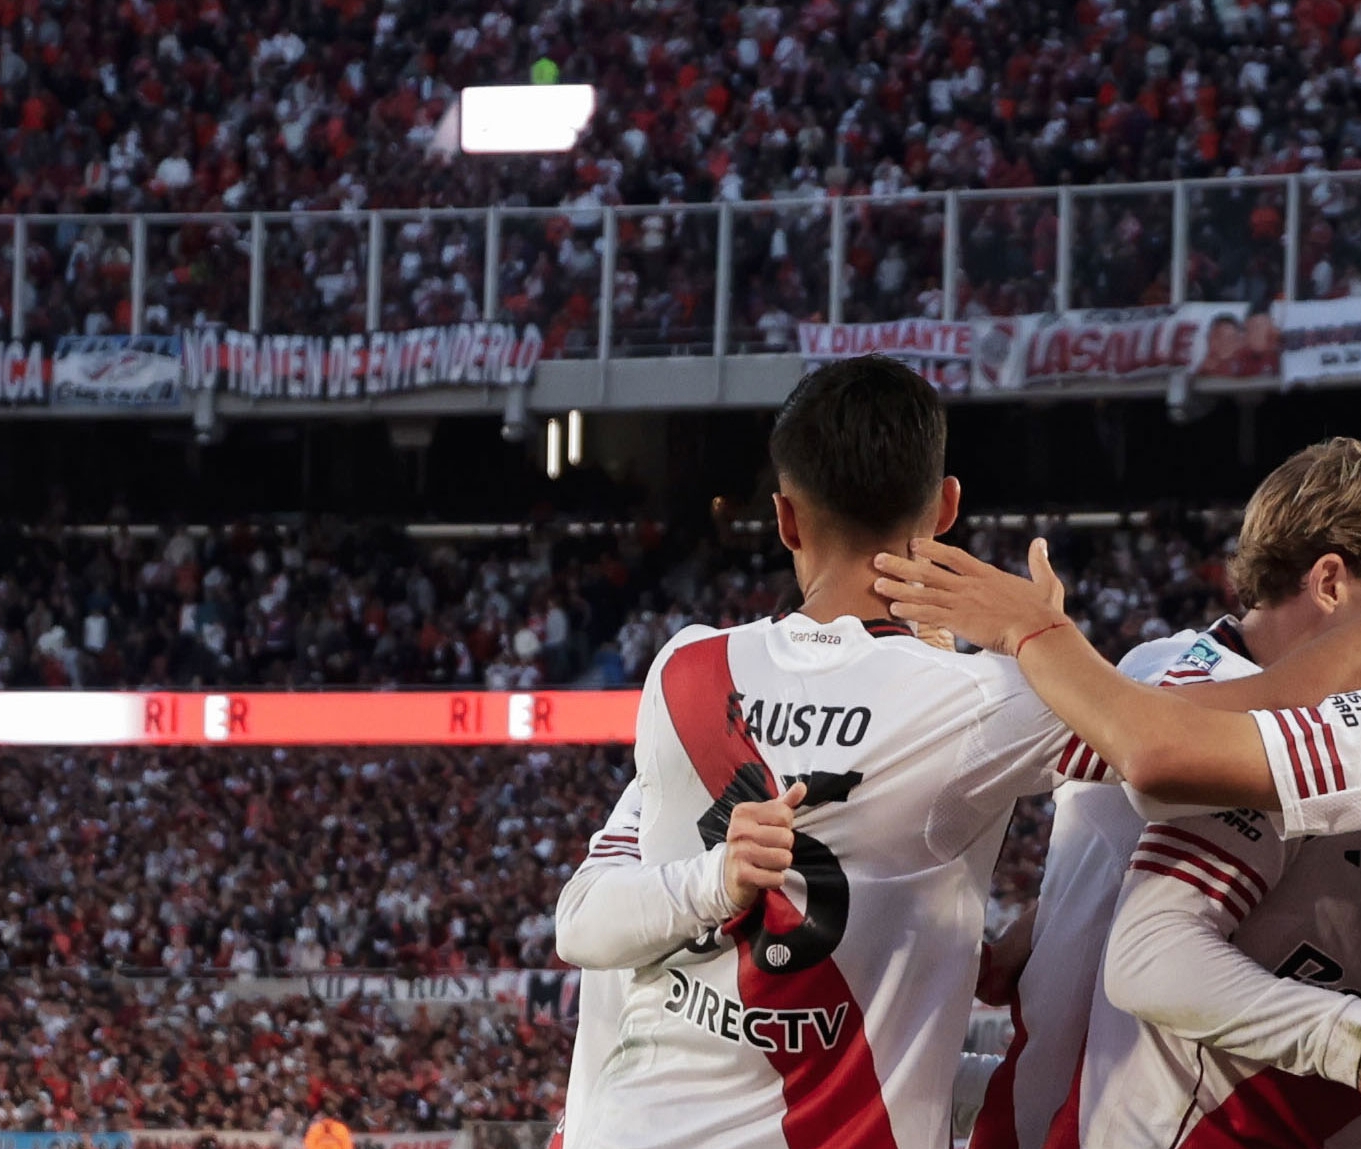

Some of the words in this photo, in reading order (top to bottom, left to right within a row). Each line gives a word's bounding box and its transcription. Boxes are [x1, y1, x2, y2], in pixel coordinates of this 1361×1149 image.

[226, 329, 324, 400] TRATEN
[326, 334, 363, 395] DE
[365, 322, 543, 396] ENTENDERLO
[790, 630, 842, 645] Grandeza
[726, 692, 872, 749] FAUSTO
[664, 967, 849, 1053] DIRECTV
